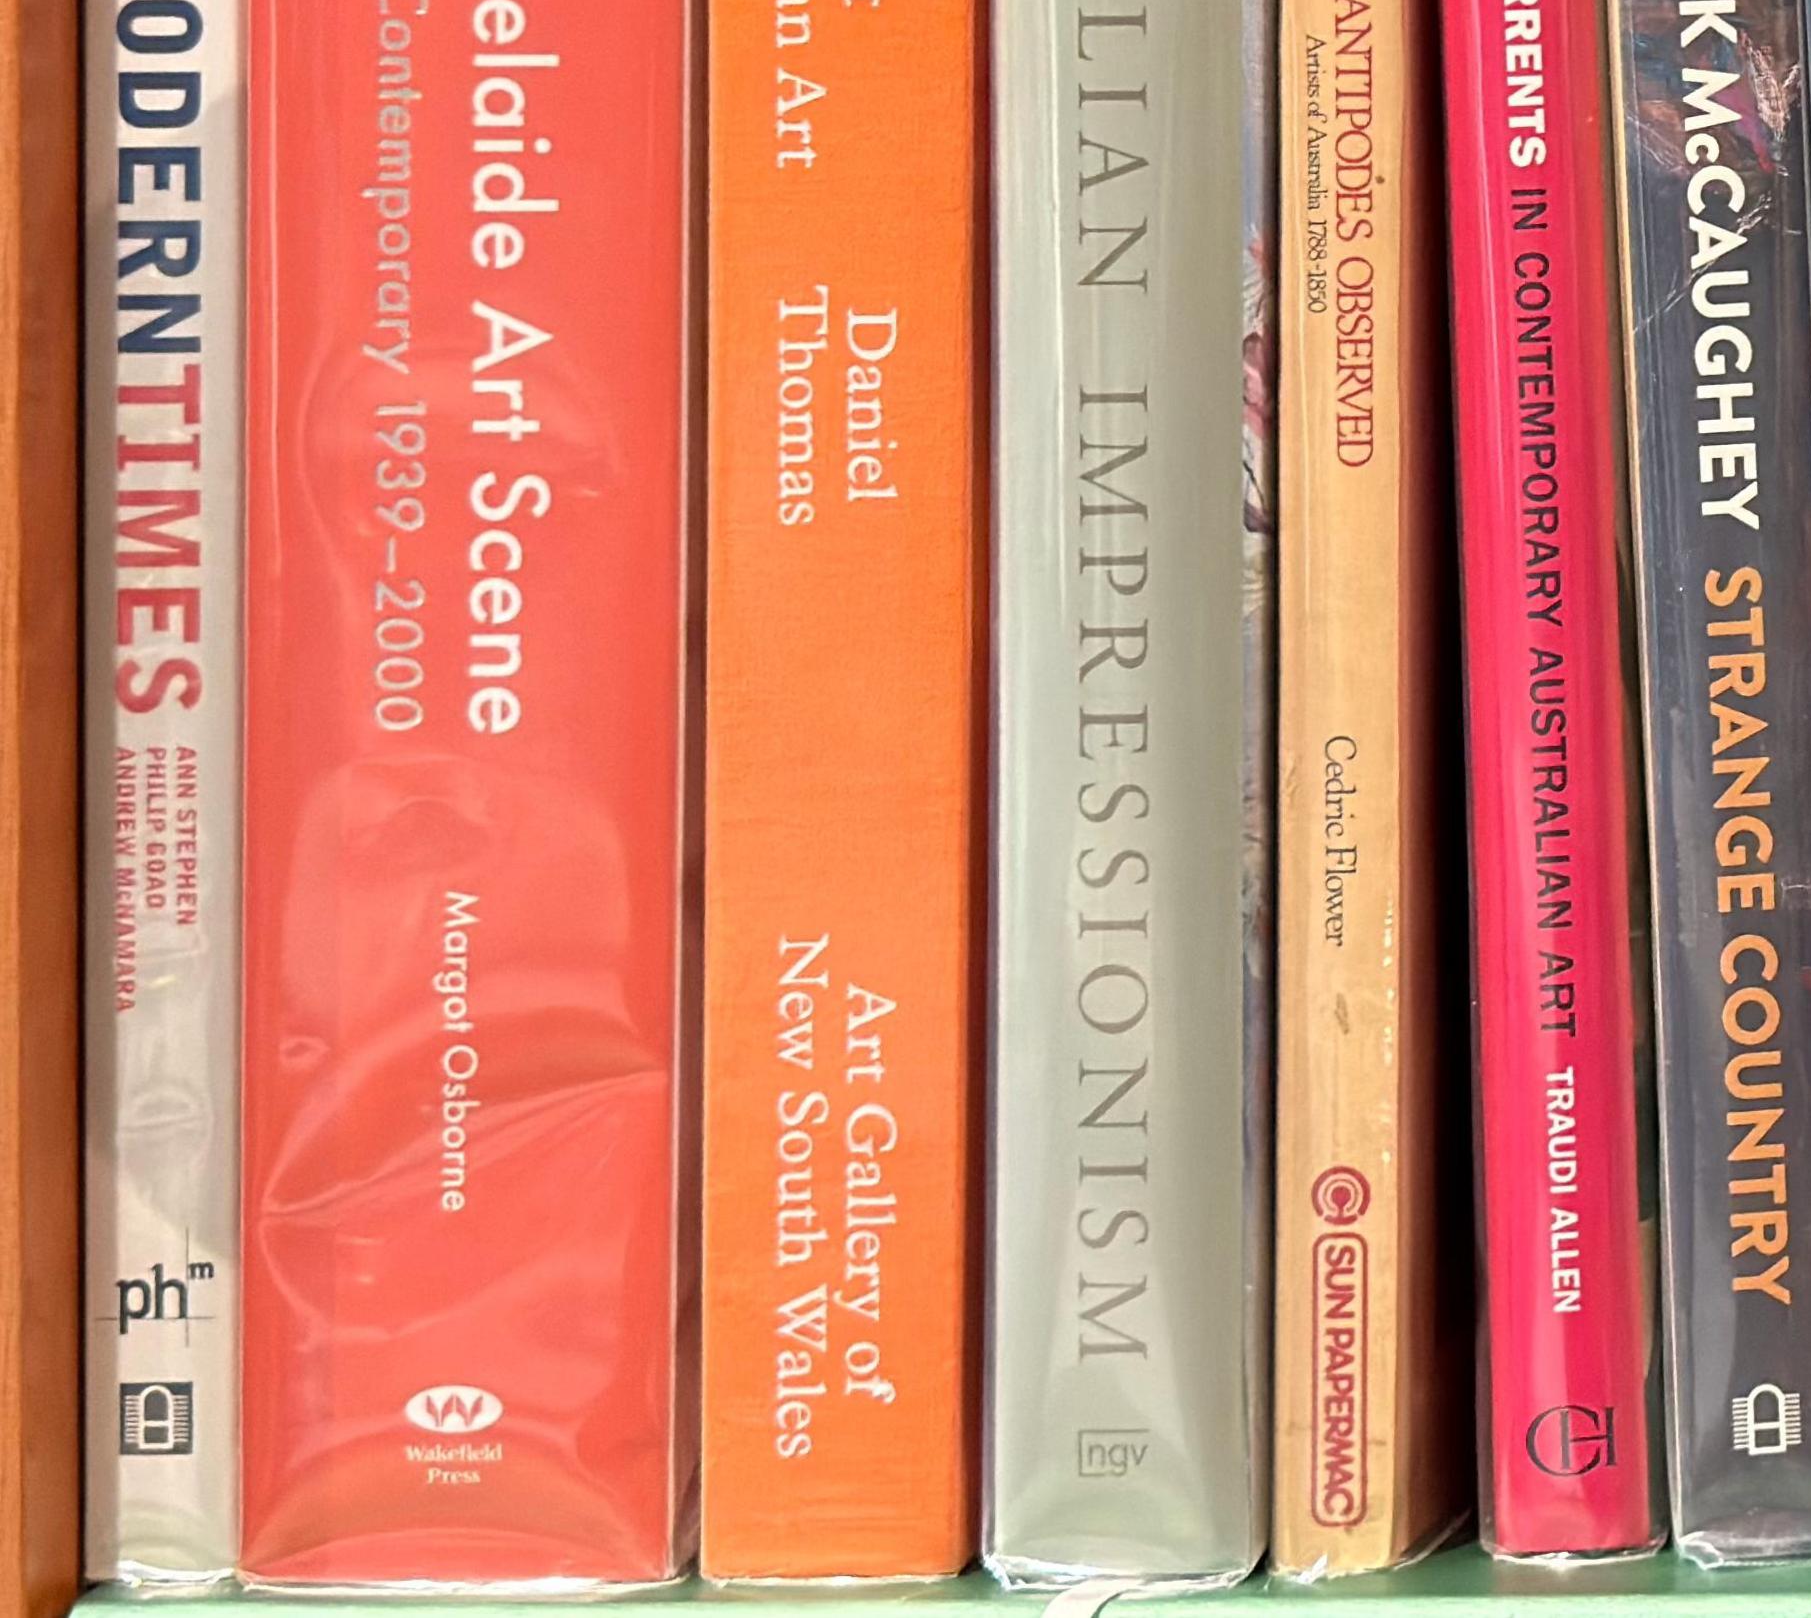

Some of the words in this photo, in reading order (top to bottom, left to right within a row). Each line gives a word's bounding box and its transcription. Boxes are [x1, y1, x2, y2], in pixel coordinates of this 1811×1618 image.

[776, 68, 827, 169] Art
[1511, 188, 1547, 231] IN
[1334, 257, 1374, 467] OBSERVED
[1678, 66, 1762, 530] McCAUGHEY
[471, 300, 555, 439] Art
[778, 284, 827, 526] Thomas
[845, 305, 897, 504] Daniel
[1510, 240, 1565, 628] CONTEMPORARY
[467, 471, 551, 736] Scene
[116, 746, 136, 855] ANDREW
[146, 746, 166, 832] PHILIP
[176, 746, 197, 798] ANN
[1323, 735, 1357, 842] Cedric
[1525, 648, 1573, 929] AUSTRALIAN
[1705, 567, 1775, 914] STRANGE
[146, 842, 166, 909] GOAD
[176, 809, 197, 924] STEPHEN
[1077, 383, 1150, 1361] IMPRESSIONISM
[1325, 847, 1357, 947] Flower
[116, 867, 136, 1012] McNAMARA
[430, 890, 479, 1036] Margot
[780, 933, 827, 1070] New
[1538, 947, 1576, 1037] ART
[847, 985, 895, 1090] Art
[439, 1045, 479, 1212] Osborne
[778, 1091, 827, 1263] South
[1546, 1065, 1576, 1196] TRAUDI
[1720, 935, 1792, 1305] COUNTRY
[834, 1104, 897, 1317] Gallery
[1323, 1234, 1361, 1320] SUN
[1549, 1205, 1582, 1314] ALLEN
[776, 1278, 825, 1458] Wales
[848, 1338, 895, 1405] of
[1318, 1324, 1361, 1521] PAPERMAC
